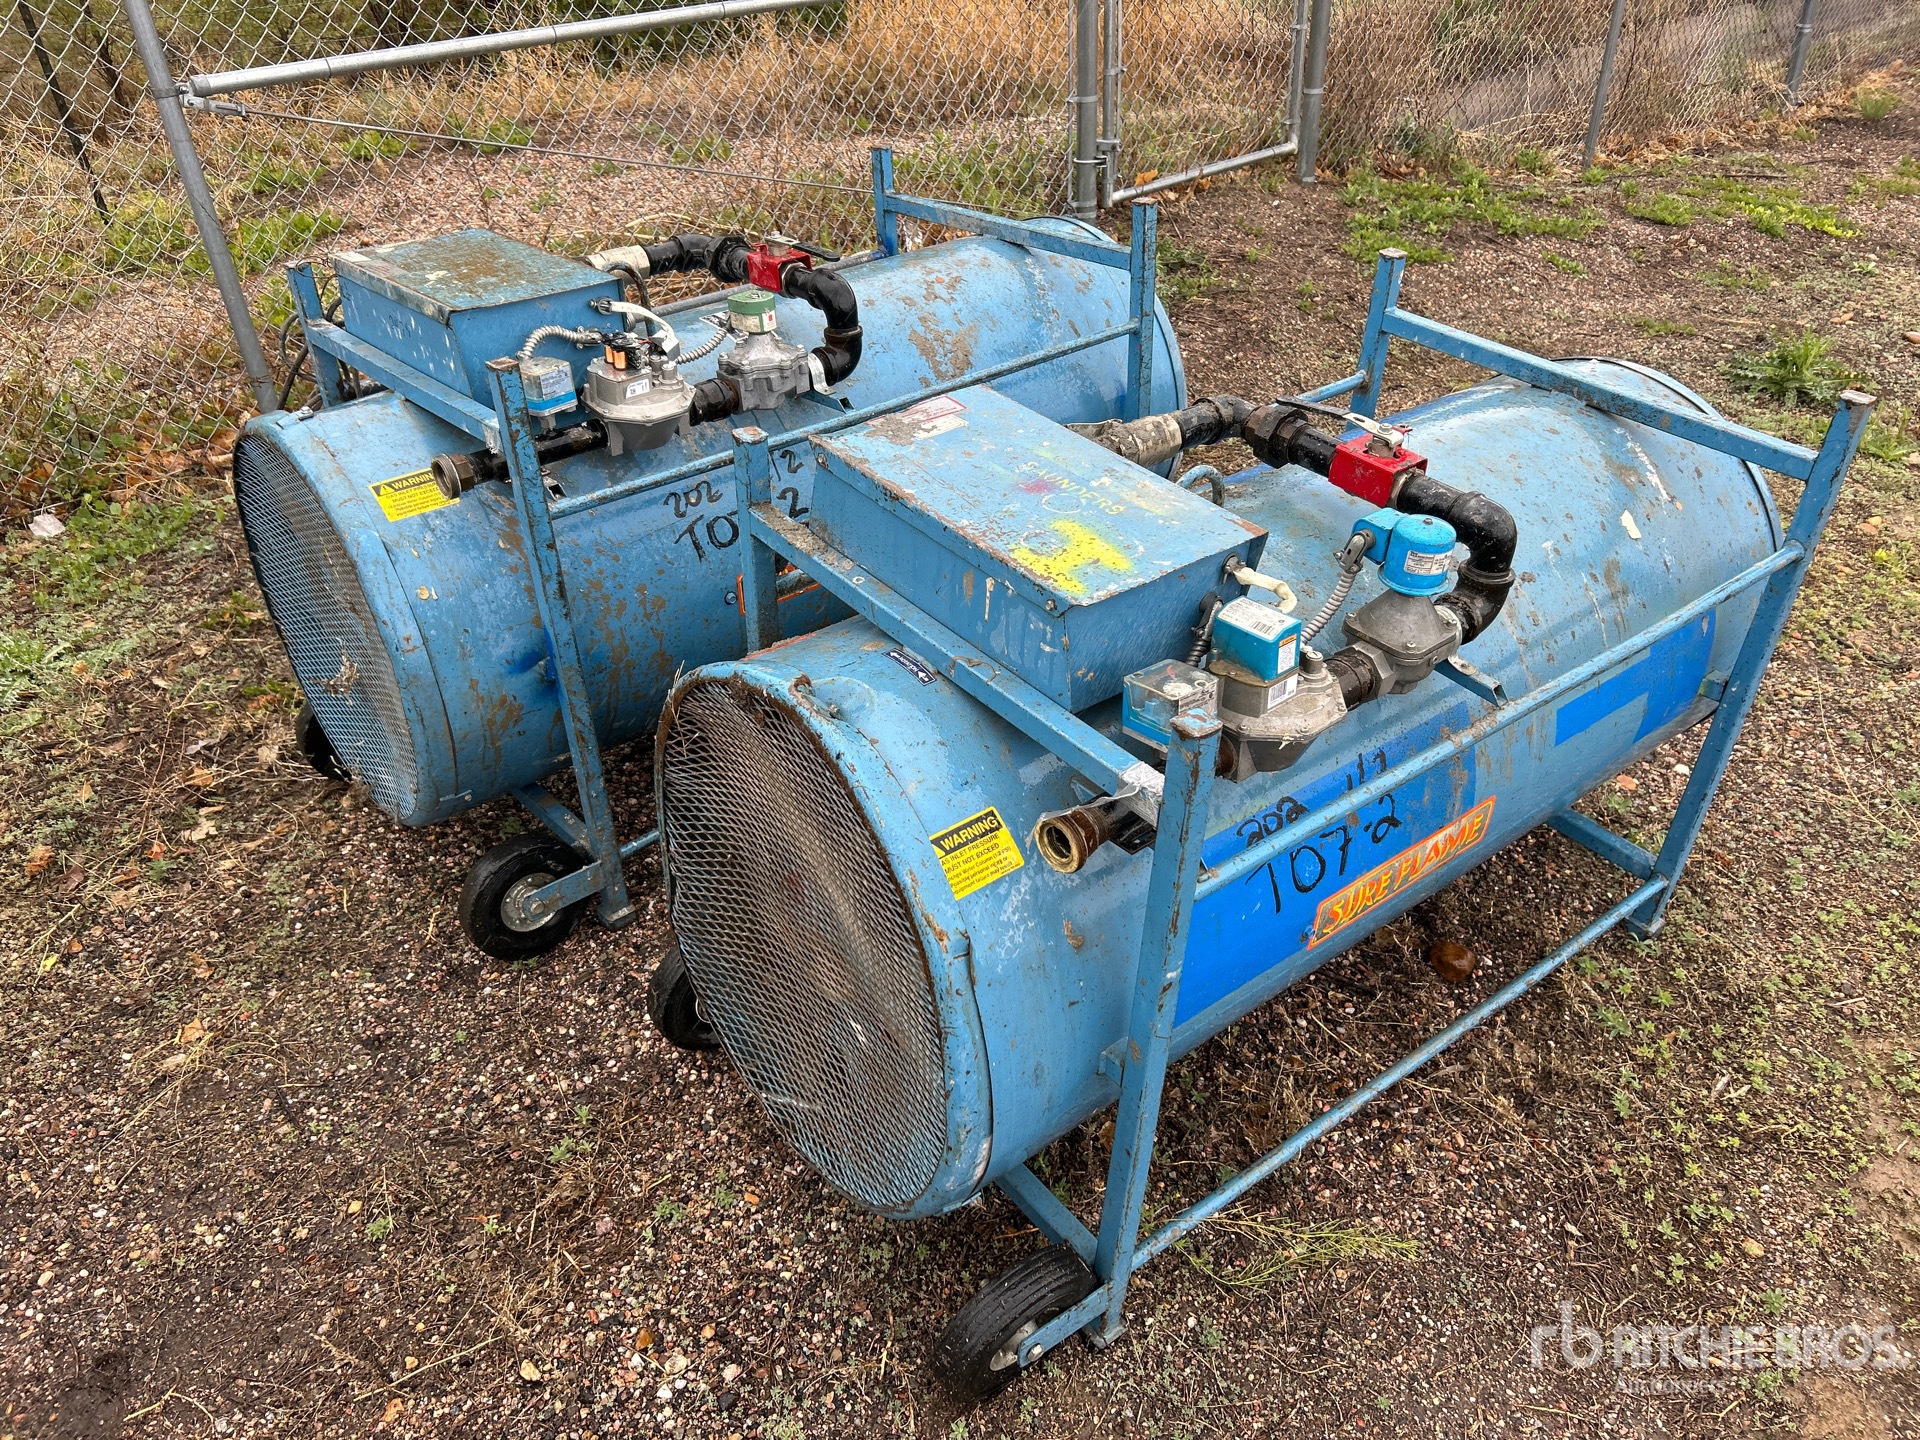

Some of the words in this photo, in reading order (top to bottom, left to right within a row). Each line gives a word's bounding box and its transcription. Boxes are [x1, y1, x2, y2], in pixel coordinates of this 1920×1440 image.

[392, 473, 435, 489] WARNIN
[413, 483, 437, 493] PRESSUR
[420, 487, 438, 496] EXCEE
[663, 480, 723, 518] 202
[1236, 795, 1310, 848] 202
[940, 816, 998, 850] WARNING
[950, 849, 967, 861] INLET
[968, 833, 999, 852] PRESSURE
[945, 862, 962, 874] MUST
[962, 855, 975, 865] NOT
[976, 843, 1000, 858] EXCEED
[976, 855, 993, 867] Column
[970, 865, 990, 880] personal
[990, 867, 1000, 876] may
[1323, 870, 1393, 933] SURE
[1395, 812, 1484, 885] FLAME
